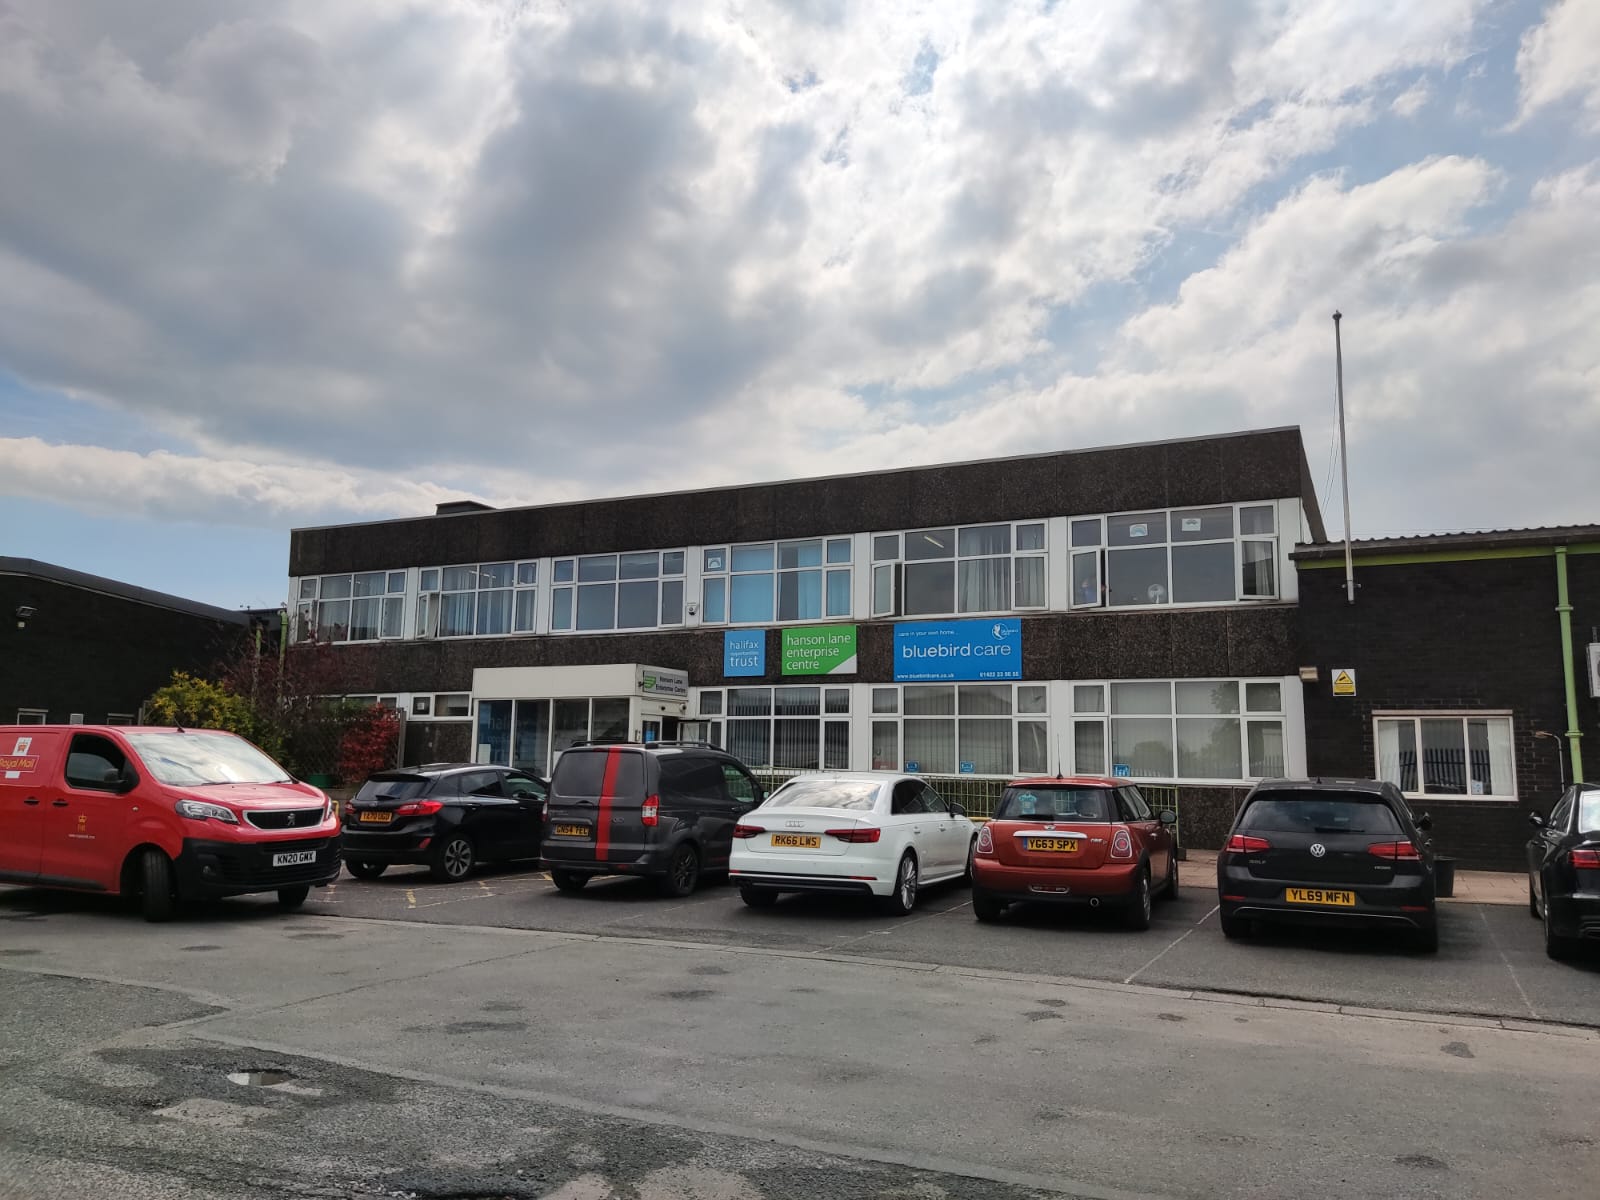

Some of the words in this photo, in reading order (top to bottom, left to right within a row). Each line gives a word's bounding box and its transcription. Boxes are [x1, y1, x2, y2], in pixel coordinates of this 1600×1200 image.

[787, 634, 825, 646] hanson
[828, 632, 851, 643] lane
[729, 640, 759, 650] halifax
[902, 643, 971, 658] bluebird
[974, 644, 1011, 656] care
[786, 646, 839, 659] enterprise
[730, 656, 758, 667] trust
[786, 660, 819, 670] centre
[0, 758, 19, 769] Royal
[18, 758, 36, 768] Mail
[775, 835, 798, 845] RK66
[800, 837, 817, 846] LWS
[1030, 839, 1054, 849] YG63
[1057, 840, 1076, 850] SPX
[277, 854, 298, 865] KN20
[1291, 889, 1323, 901] YL69
[1325, 891, 1350, 903] MFN
